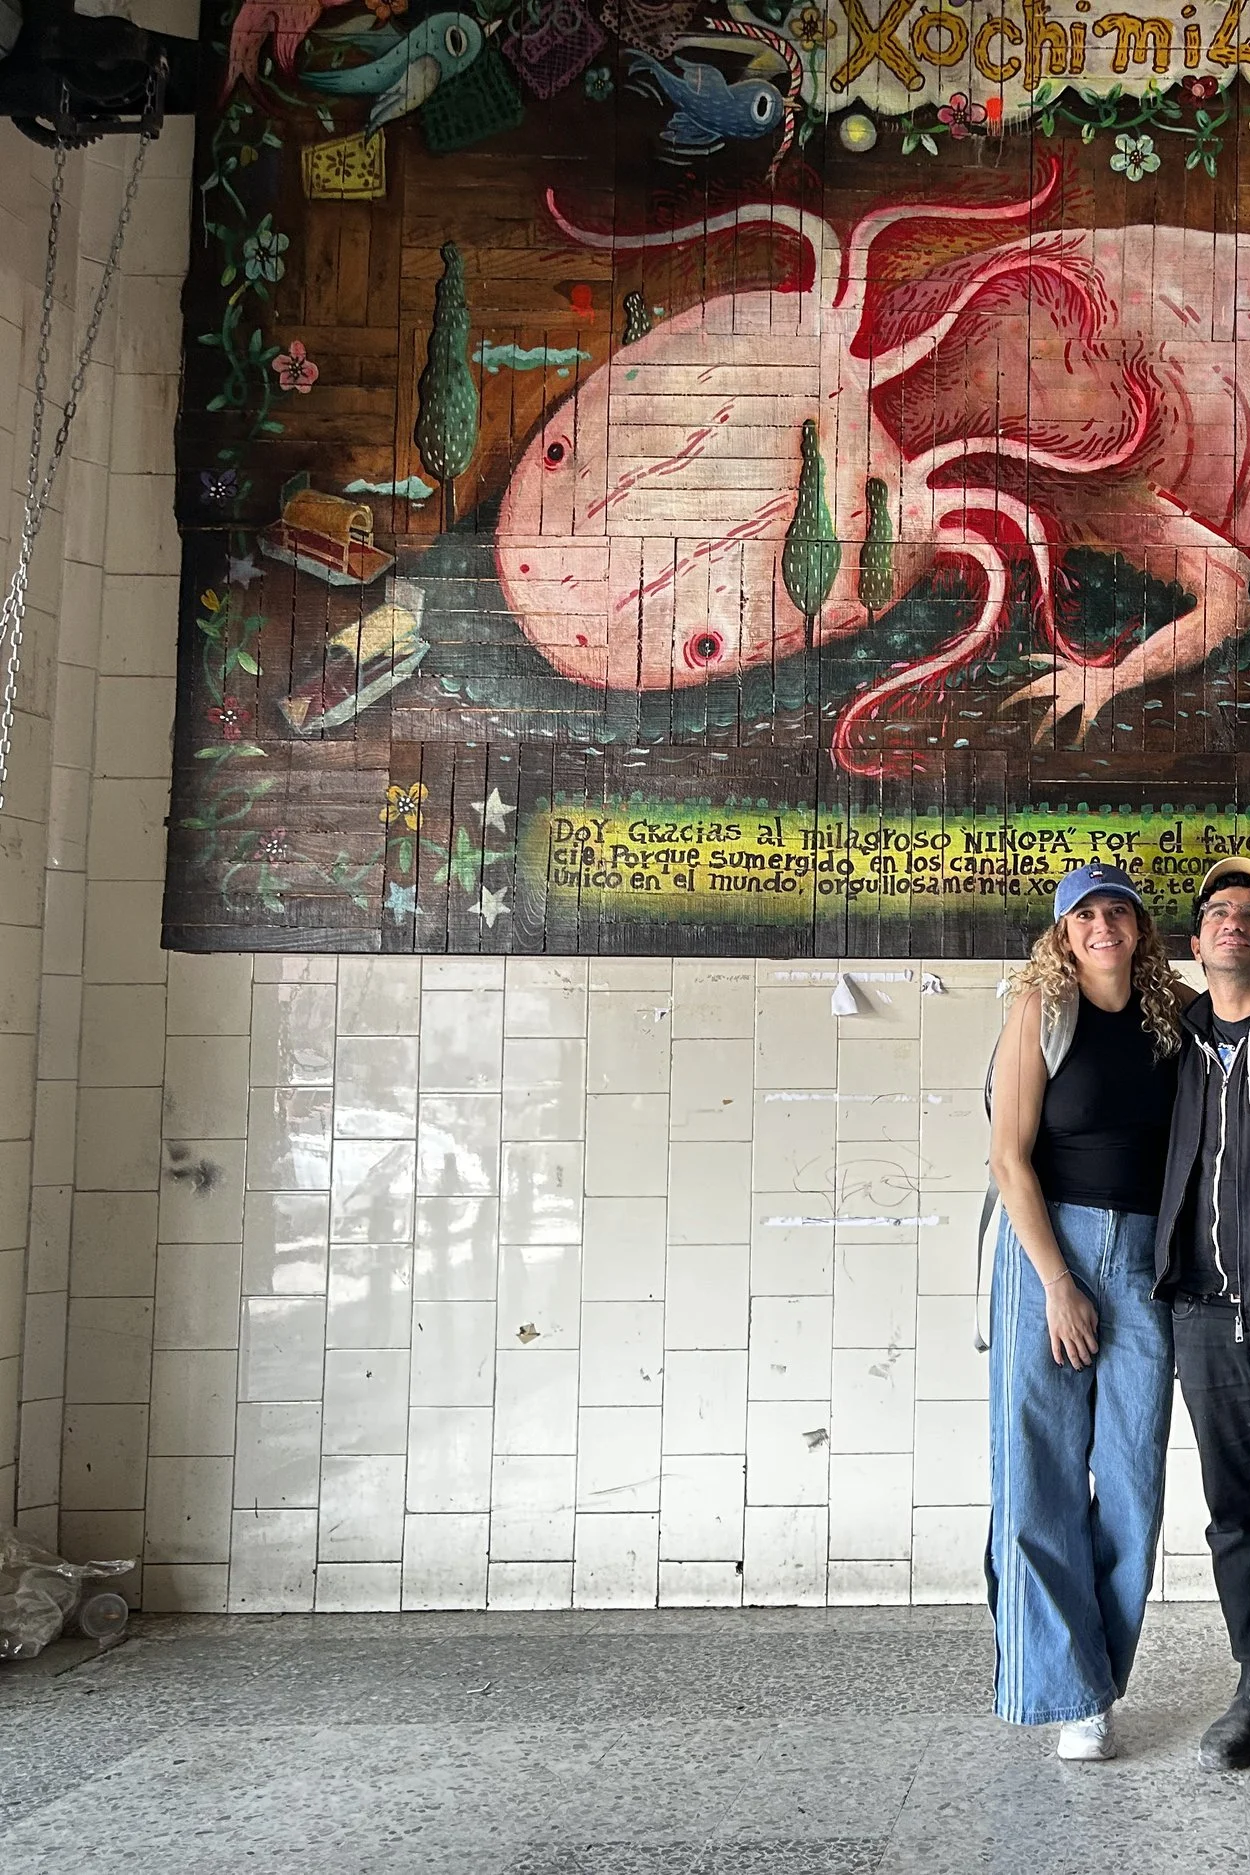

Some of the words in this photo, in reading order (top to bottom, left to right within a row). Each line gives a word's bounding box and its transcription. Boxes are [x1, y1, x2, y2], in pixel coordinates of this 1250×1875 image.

[757, 816, 786, 847] al
[800, 822, 951, 856] milagroso
[1160, 821, 1184, 853] el
[708, 848, 854, 877] sumergido
[870, 852, 897, 874] en
[904, 850, 942, 874] los
[949, 852, 1050, 875] canales
[1113, 853, 1144, 874] he
[630, 869, 660, 891] en
[674, 868, 696, 892] el
[818, 873, 1021, 900] orgullosamente
